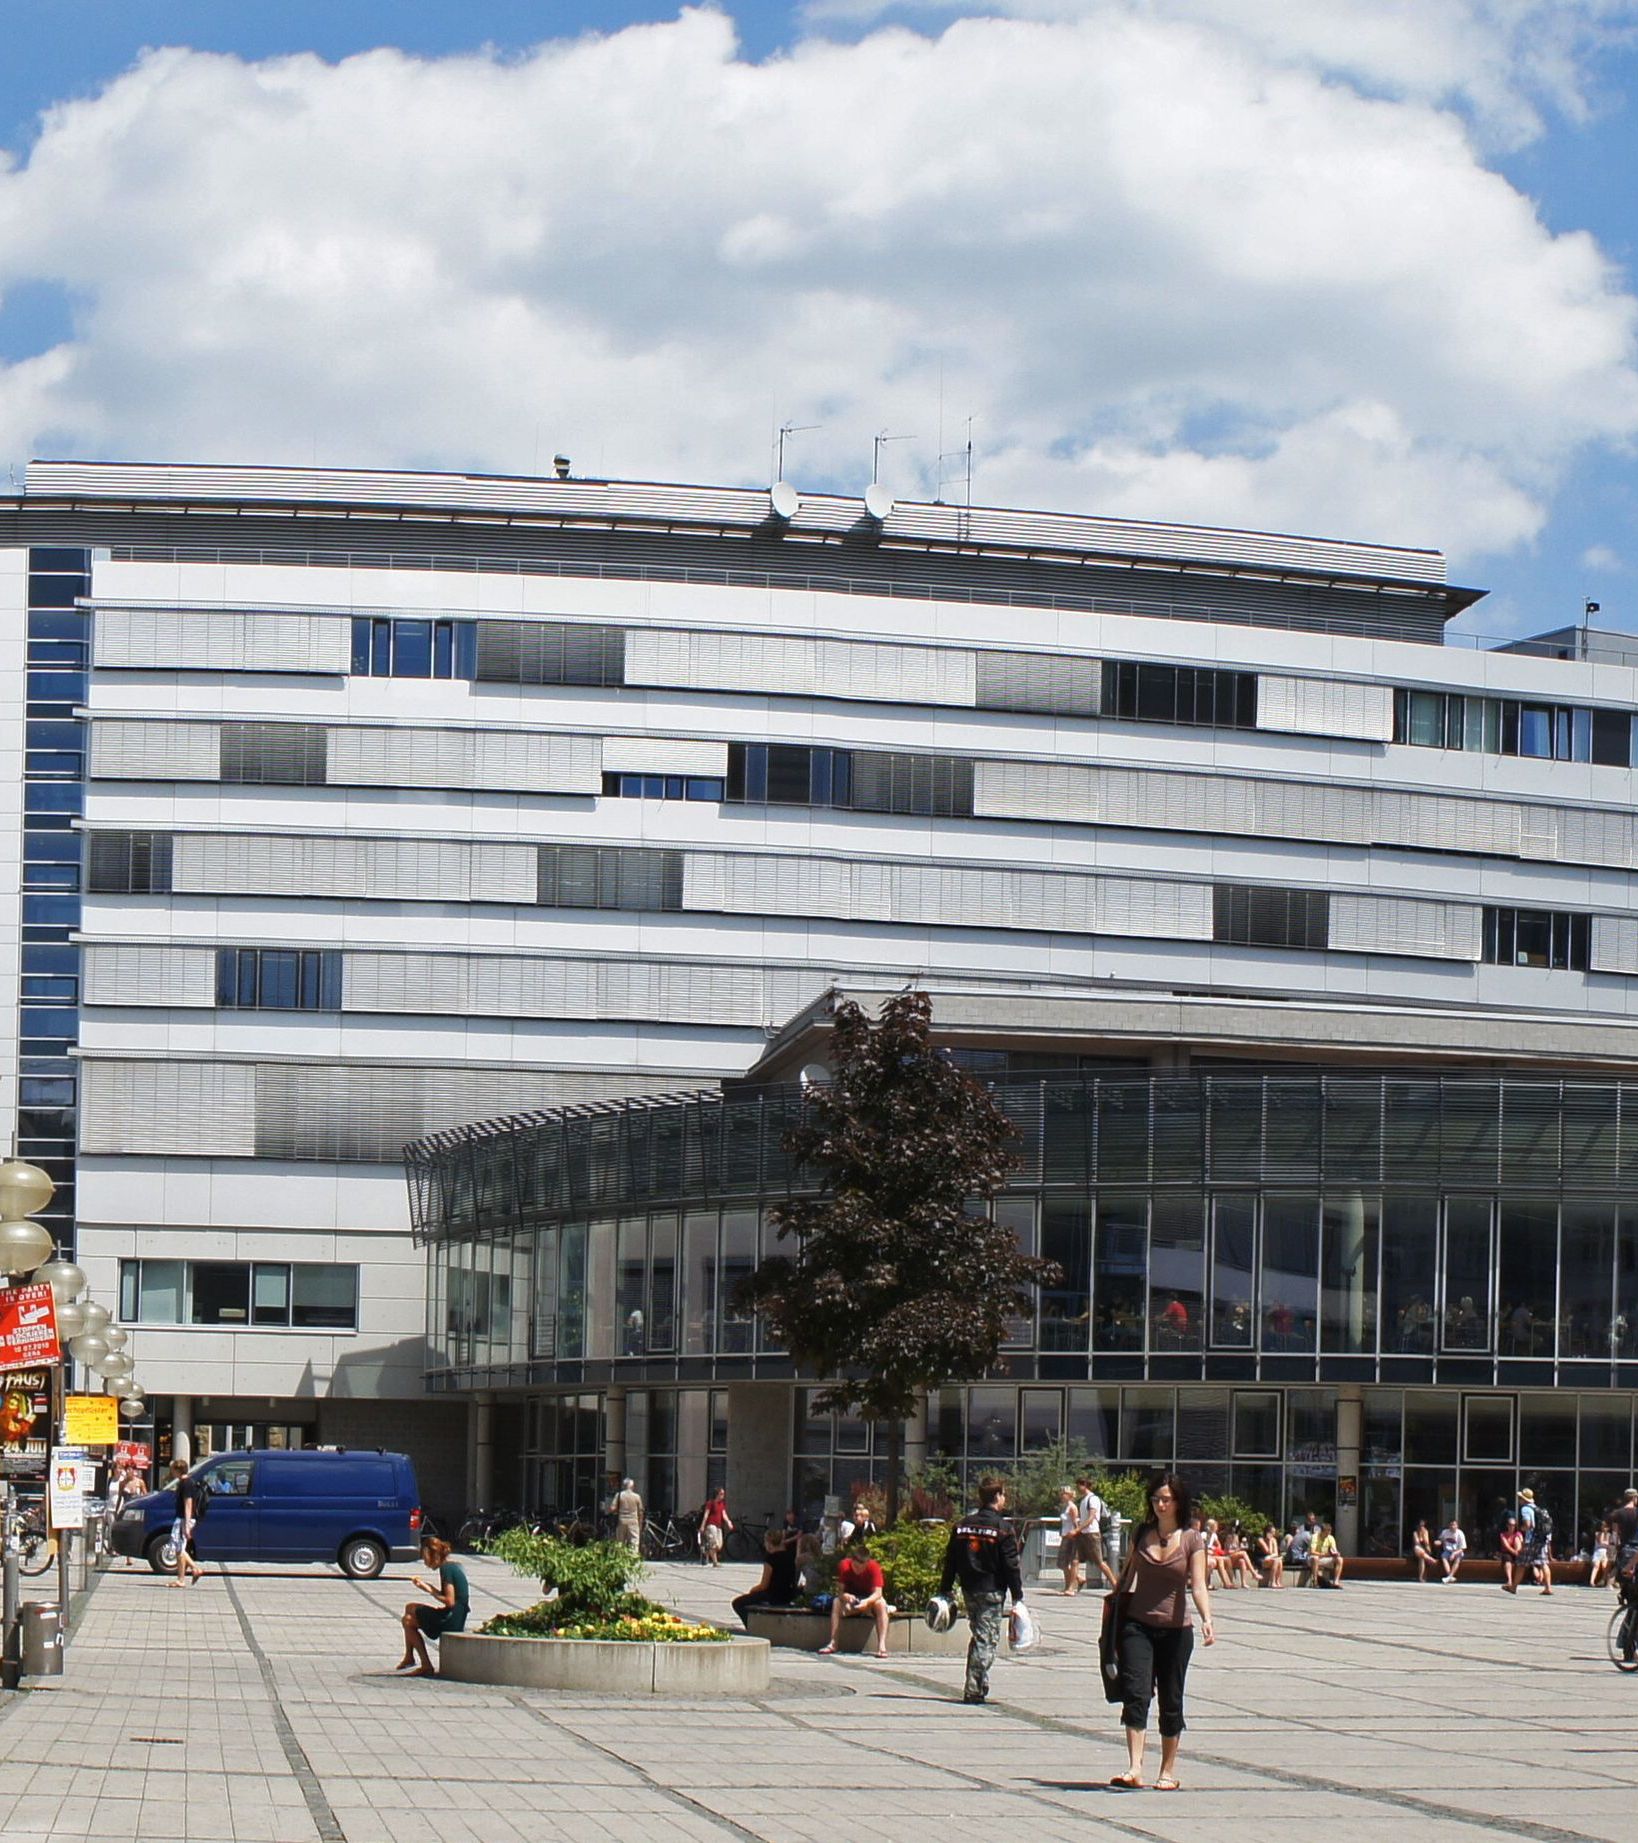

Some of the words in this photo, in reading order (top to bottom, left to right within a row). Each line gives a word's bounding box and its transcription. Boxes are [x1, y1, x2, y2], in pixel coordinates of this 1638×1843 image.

[21, 1284, 50, 1294] PARTY
[18, 1291, 47, 1301] OVER!
[5, 1373, 47, 1392] FAUST
[24, 1440, 47, 1454] JULI
